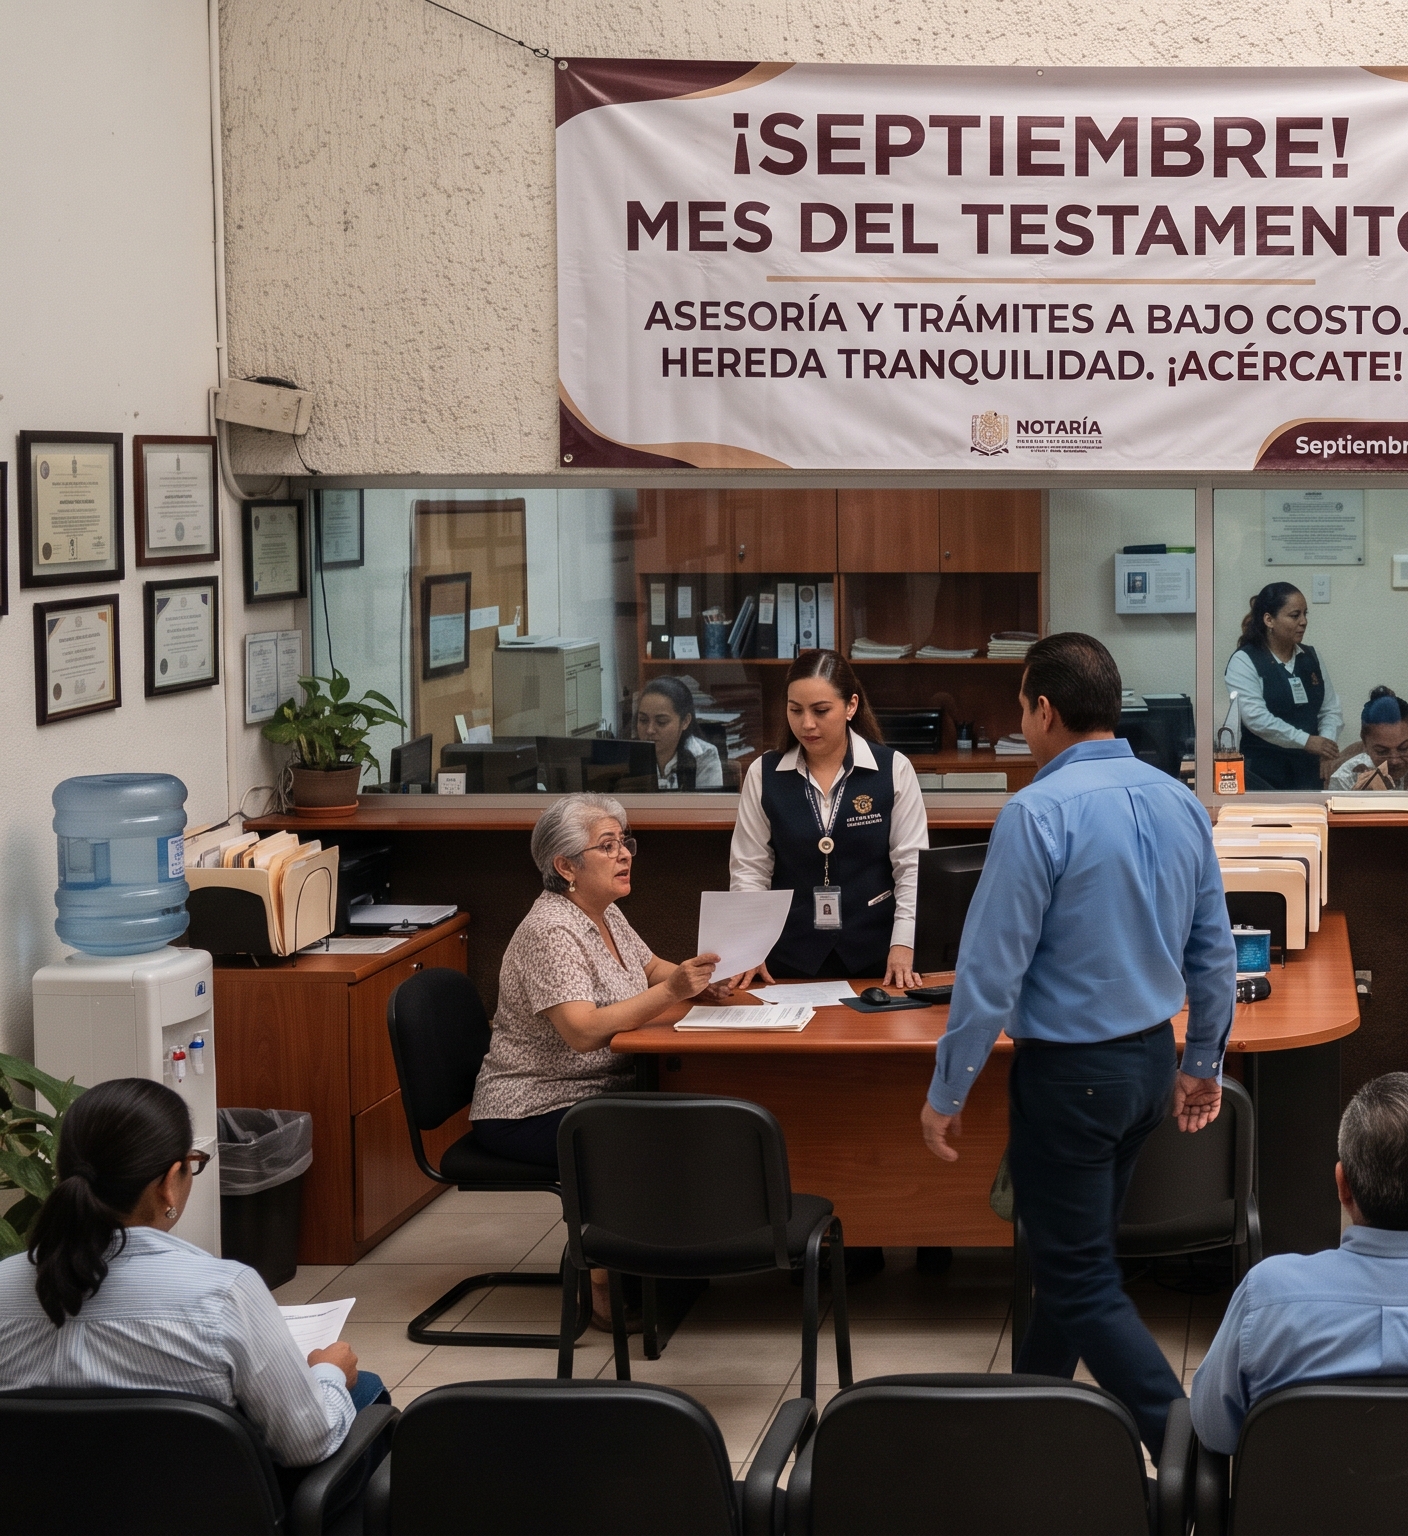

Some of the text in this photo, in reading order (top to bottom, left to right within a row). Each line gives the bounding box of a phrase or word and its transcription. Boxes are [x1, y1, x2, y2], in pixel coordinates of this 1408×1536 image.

[733, 113, 1349, 178] ¡SEPTIEMBRE!
[627, 201, 772, 253] MES
[801, 203, 939, 254] DEL
[644, 294, 847, 331] ASESORÍA
[857, 303, 883, 332] Y
[894, 295, 1094, 333] TRÁMITES
[1105, 305, 1134, 333] A
[1148, 305, 1253, 334] BAJO
[661, 343, 1402, 386] HEREDA TRANQUILIDAD. ¡ACÉRCATE!
[1016, 416, 1101, 434] NOTARÍA
